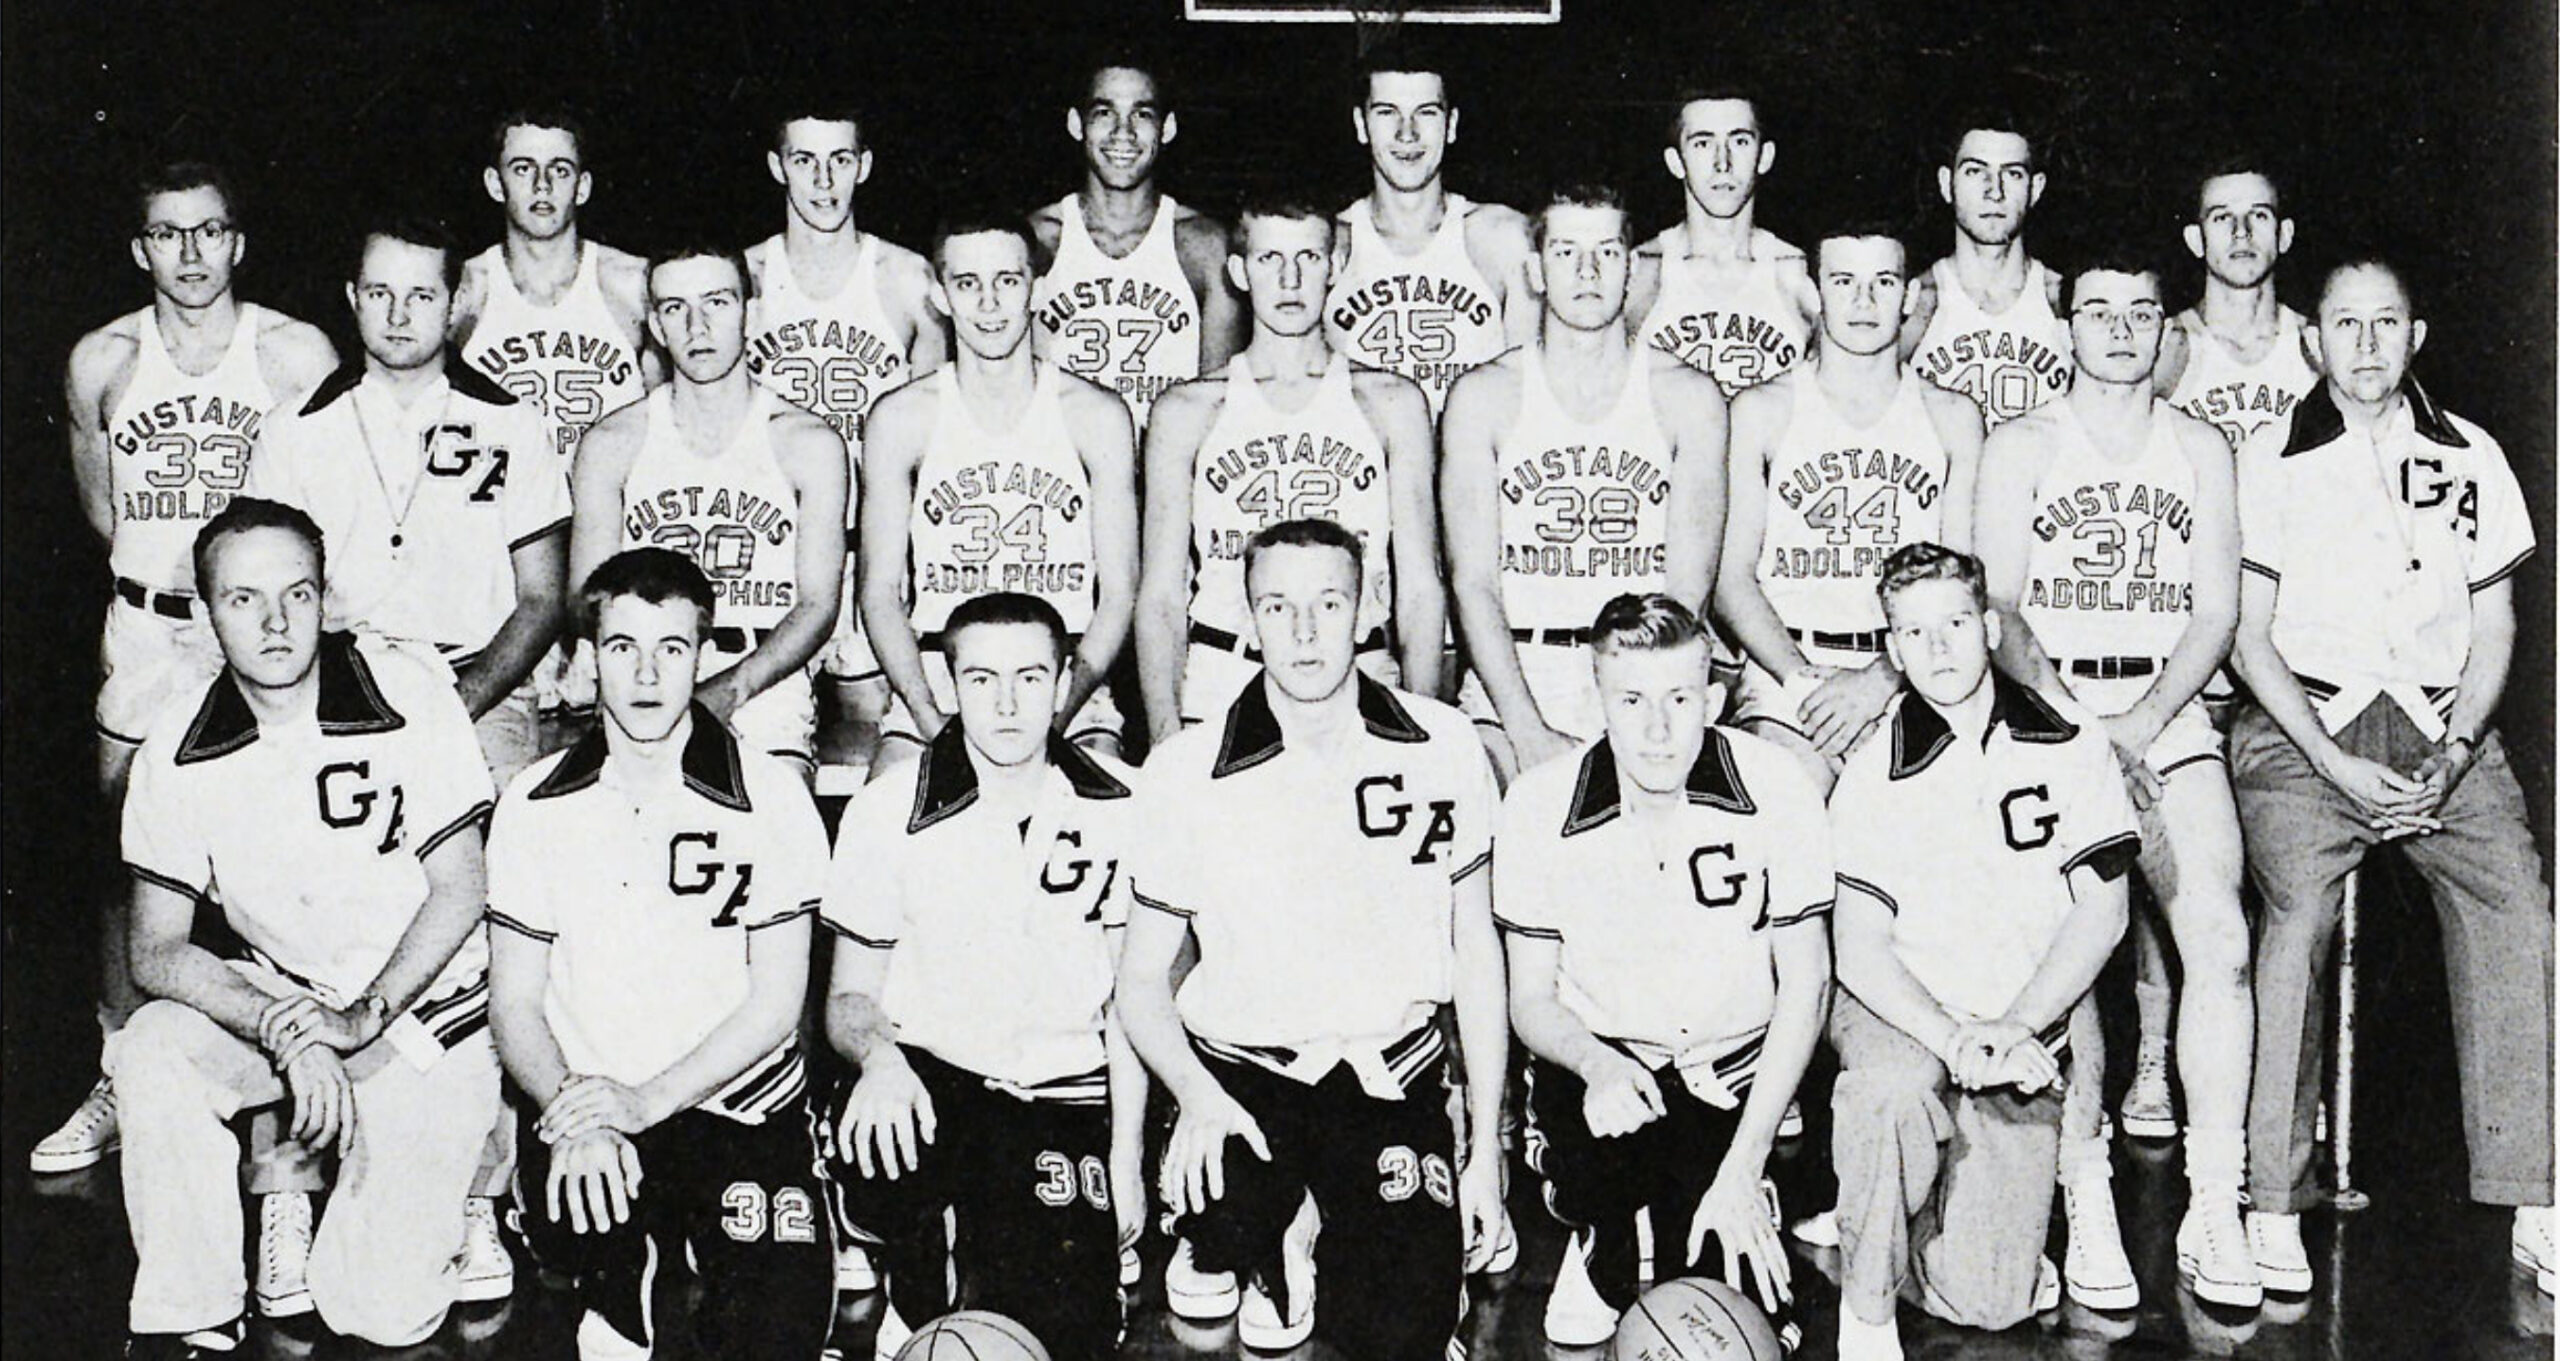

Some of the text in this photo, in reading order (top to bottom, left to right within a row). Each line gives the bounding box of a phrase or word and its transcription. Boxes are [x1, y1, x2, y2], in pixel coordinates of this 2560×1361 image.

[1038, 277, 1190, 334] GUSTAVUS
[1332, 274, 1492, 332] GUSTAVUS
[477, 330, 632, 386] USTAVUS
[746, 318, 900, 379] GUSTAVUS
[1065, 319, 1163, 373] 37
[1357, 309, 1456, 364] 45
[1654, 311, 1796, 368] USTAVUS
[771, 357, 868, 412] 36
[1951, 363, 2038, 420] 40
[115, 395, 261, 456] GUSTAVU
[146, 432, 251, 489] 33
[1205, 432, 1377, 494] GUSTAVUS
[1500, 445, 1671, 506] GUSTAVUS
[1778, 448, 1939, 511] GUSTAVUS
[123, 490, 232, 521] ADOLP
[626, 486, 793, 546] GUSTAVUS
[923, 461, 1083, 526] GUSTAVUS
[1236, 470, 1340, 527] 42
[1534, 486, 1640, 544] 38
[1803, 485, 1900, 545] 44
[2032, 481, 2193, 544] GUSTAVUS
[2400, 456, 2478, 541] GA
[950, 503, 1047, 562] 34
[1502, 543, 1667, 577] ADOLPHUS
[2072, 518, 2159, 579] 31
[922, 562, 1085, 593] ADOLPHUS
[1771, 546, 1894, 579] ADOLPH
[2028, 577, 2193, 613] ADOLPHUS
[1355, 774, 1456, 865] GA
[1035, 1149, 1110, 1211] 30
[1377, 1145, 1454, 1208] 38
[721, 1181, 816, 1244] 32
